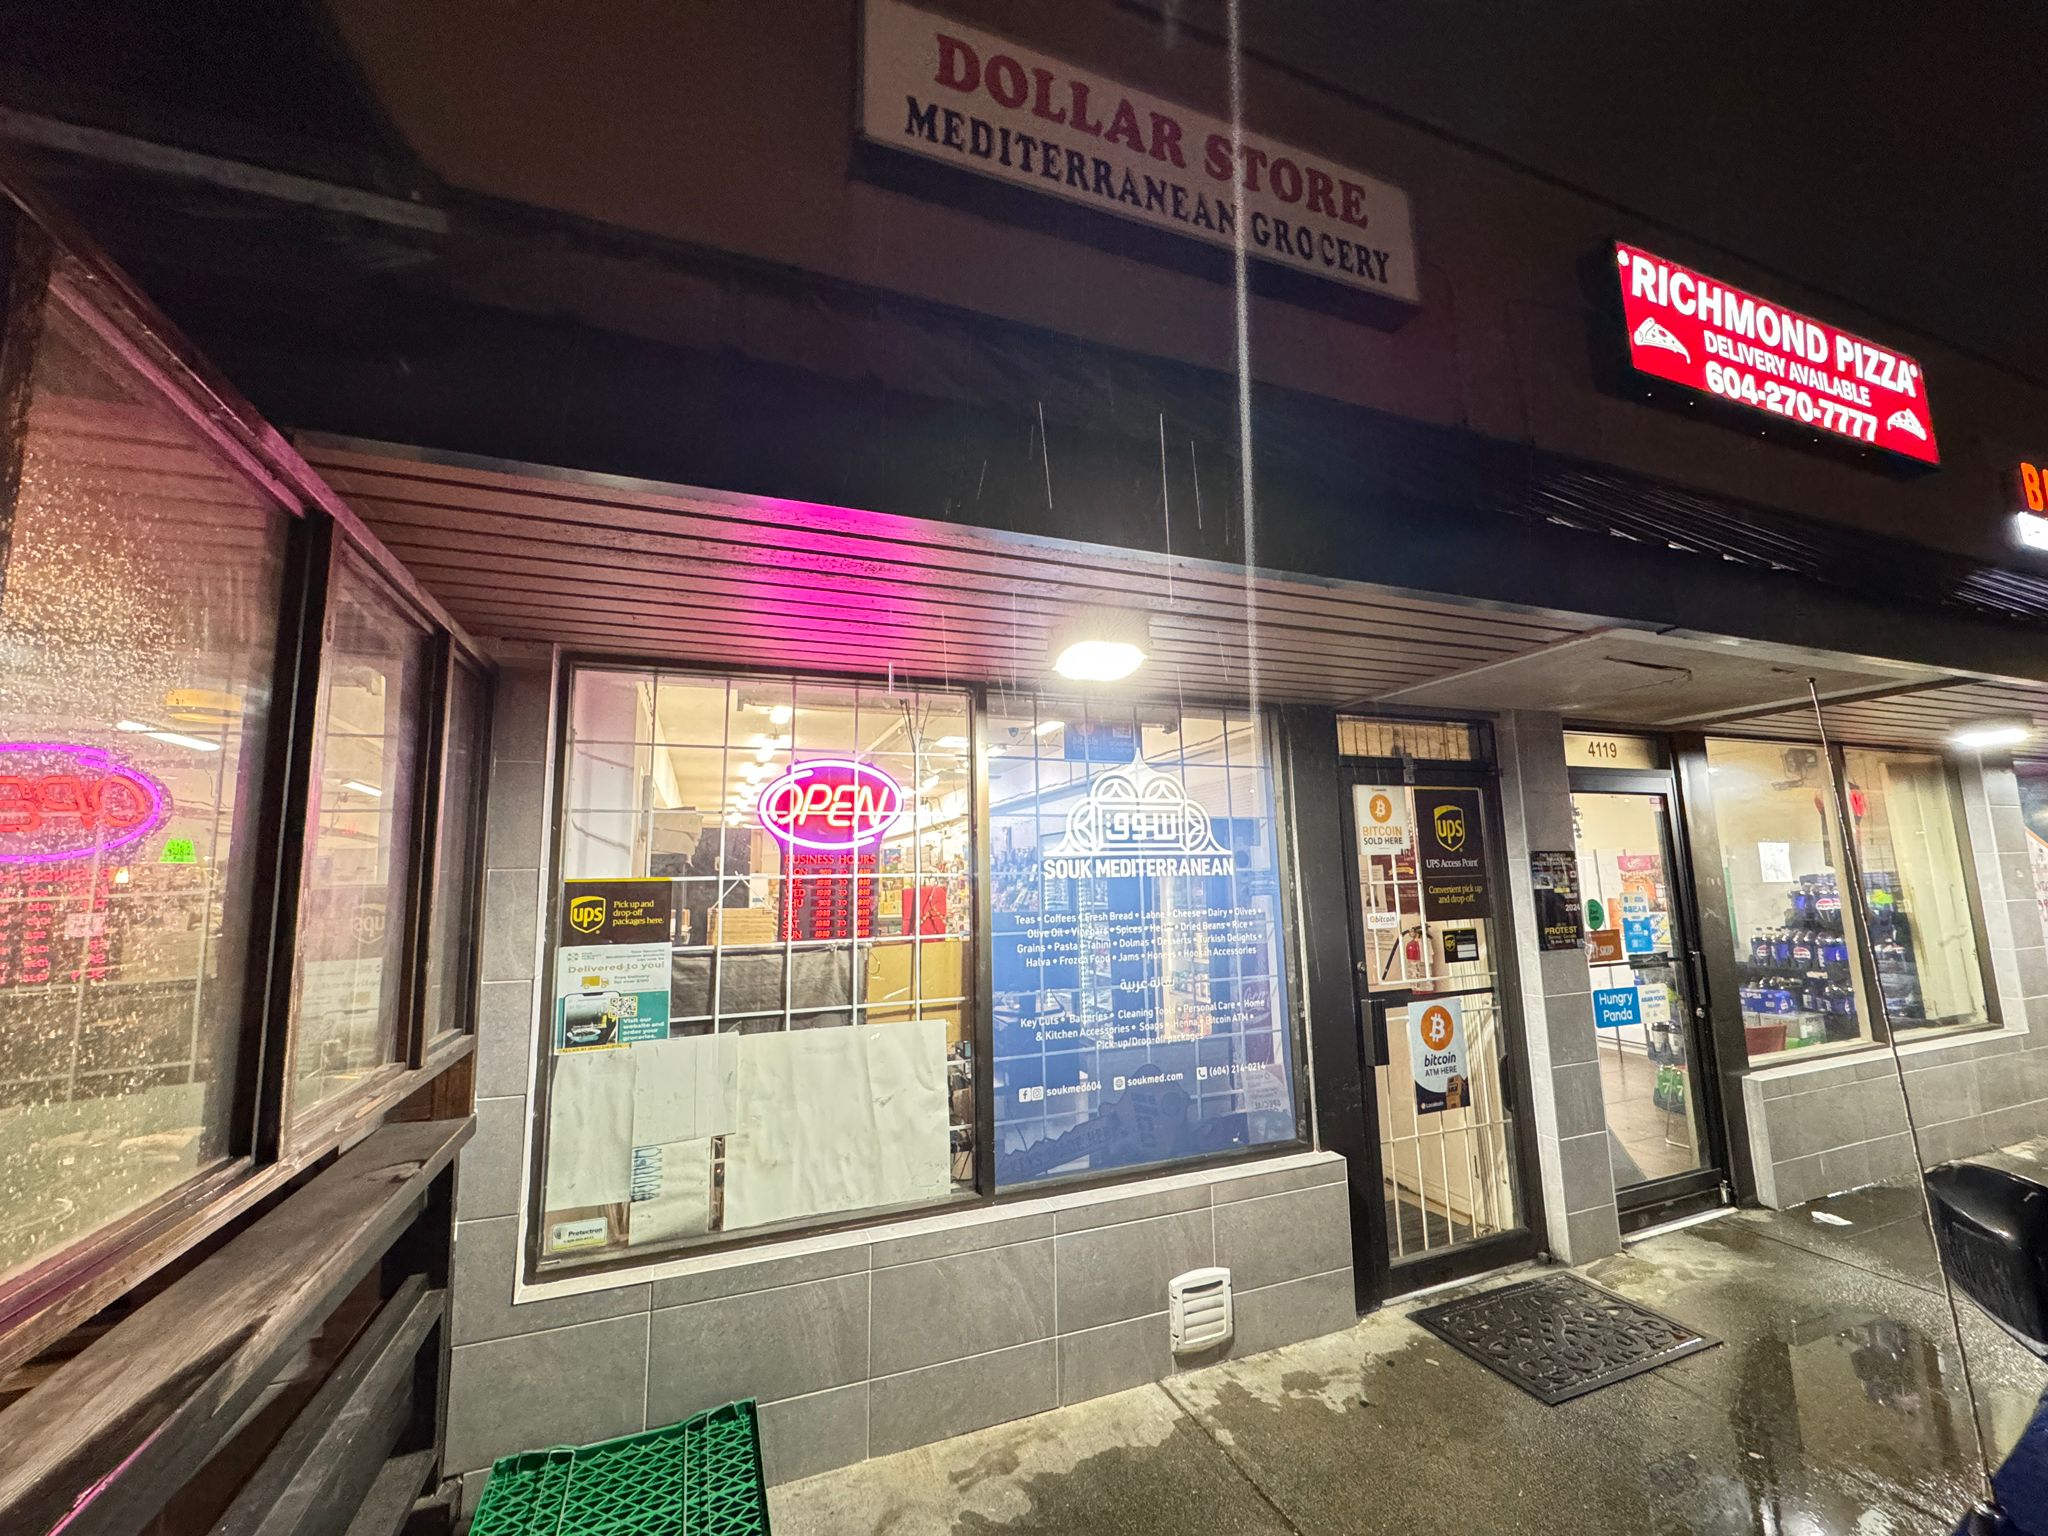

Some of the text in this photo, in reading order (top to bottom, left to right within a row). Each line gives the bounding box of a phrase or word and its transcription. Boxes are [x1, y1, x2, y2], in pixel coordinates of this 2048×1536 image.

[935, 33, 1369, 230] DOLLAR STORE
[904, 95, 1390, 285] MEDITERRANEAN GROCERY
[1631, 255, 1918, 399] RICHMOND PIZZA
[1703, 328, 1872, 408] DELIVERY AVAILABLE
[1705, 359, 1878, 443] 604-270-7777
[1588, 741, 1617, 759] 4119
[770, 784, 889, 828] OPEN
[1105, 812, 1177, 841] سوق
[1362, 826, 1402, 837] BITCOIN
[1363, 836, 1403, 846] SOLD HERE
[784, 854, 877, 865] BUSINESS HOURS
[1425, 858, 1440, 869] UPS
[1440, 858, 1461, 868] Access
[1461, 858, 1479, 868] Point
[1043, 857, 1234, 880] SOUK MEDITERRANEAN
[1428, 884, 1483, 894] Convenient pick up
[613, 900, 655, 910] Pick up and
[1438, 894, 1450, 904] and
[1564, 903, 1580, 912] 2024
[573, 906, 603, 928] ups
[612, 908, 644, 919] drop-off
[612, 916, 665, 927] packages here.
[1014, 914, 1036, 925] Teas
[1043, 914, 1077, 924] Coffees
[1084, 912, 1108, 922] Fresh
[1109, 911, 1134, 921] Bread
[1172, 908, 1201, 918] Cheese
[1207, 907, 1228, 919] Dairy
[1234, 907, 1257, 916] Olives
[1026, 928, 1050, 939] Olive
[1050, 927, 1064, 938] Oil
[1115, 925, 1143, 936] Spices
[1180, 922, 1201, 931] Dried
[1202, 920, 1226, 930] Beans
[1231, 920, 1248, 929] Rice
[1544, 926, 1578, 935] PROTEST
[1016, 943, 1046, 954] Grains
[1054, 941, 1078, 952] Pasta
[1086, 940, 1112, 949] Tahini
[1119, 938, 1150, 948] Dolmas
[1199, 933, 1226, 943] Turkish
[1226, 932, 1258, 944] Delights
[1025, 957, 1051, 968] Halva
[1059, 955, 1089, 965] Frozen
[1089, 954, 1111, 963] Food
[1118, 952, 1140, 962] Jams
[1213, 946, 1257, 957] Accessories
[568, 961, 665, 974] Delivered to you!
[1598, 991, 1633, 1007] Hungry
[1020, 1018, 1037, 1029] Key
[1038, 1016, 1059, 1026] Cuts
[1069, 1011, 1109, 1024] Batteries
[1117, 1008, 1154, 1020] Cleaning
[1183, 1001, 1217, 1013] Personal
[1217, 1001, 1236, 1010] Care
[1243, 999, 1265, 1008] Home
[1603, 1007, 1634, 1022] Panda
[1035, 1014, 1249, 1042] & Kitchen Accessories Soaps Henna Bitcoin ATM
[1424, 1052, 1457, 1068] bitcoin
[1209, 1062, 1267, 1078] (604) 214-0214
[1425, 1065, 1458, 1077] ATM HERE
[1127, 1071, 1184, 1088] soukmed.com
[1046, 1081, 1102, 1098] soukmed604
